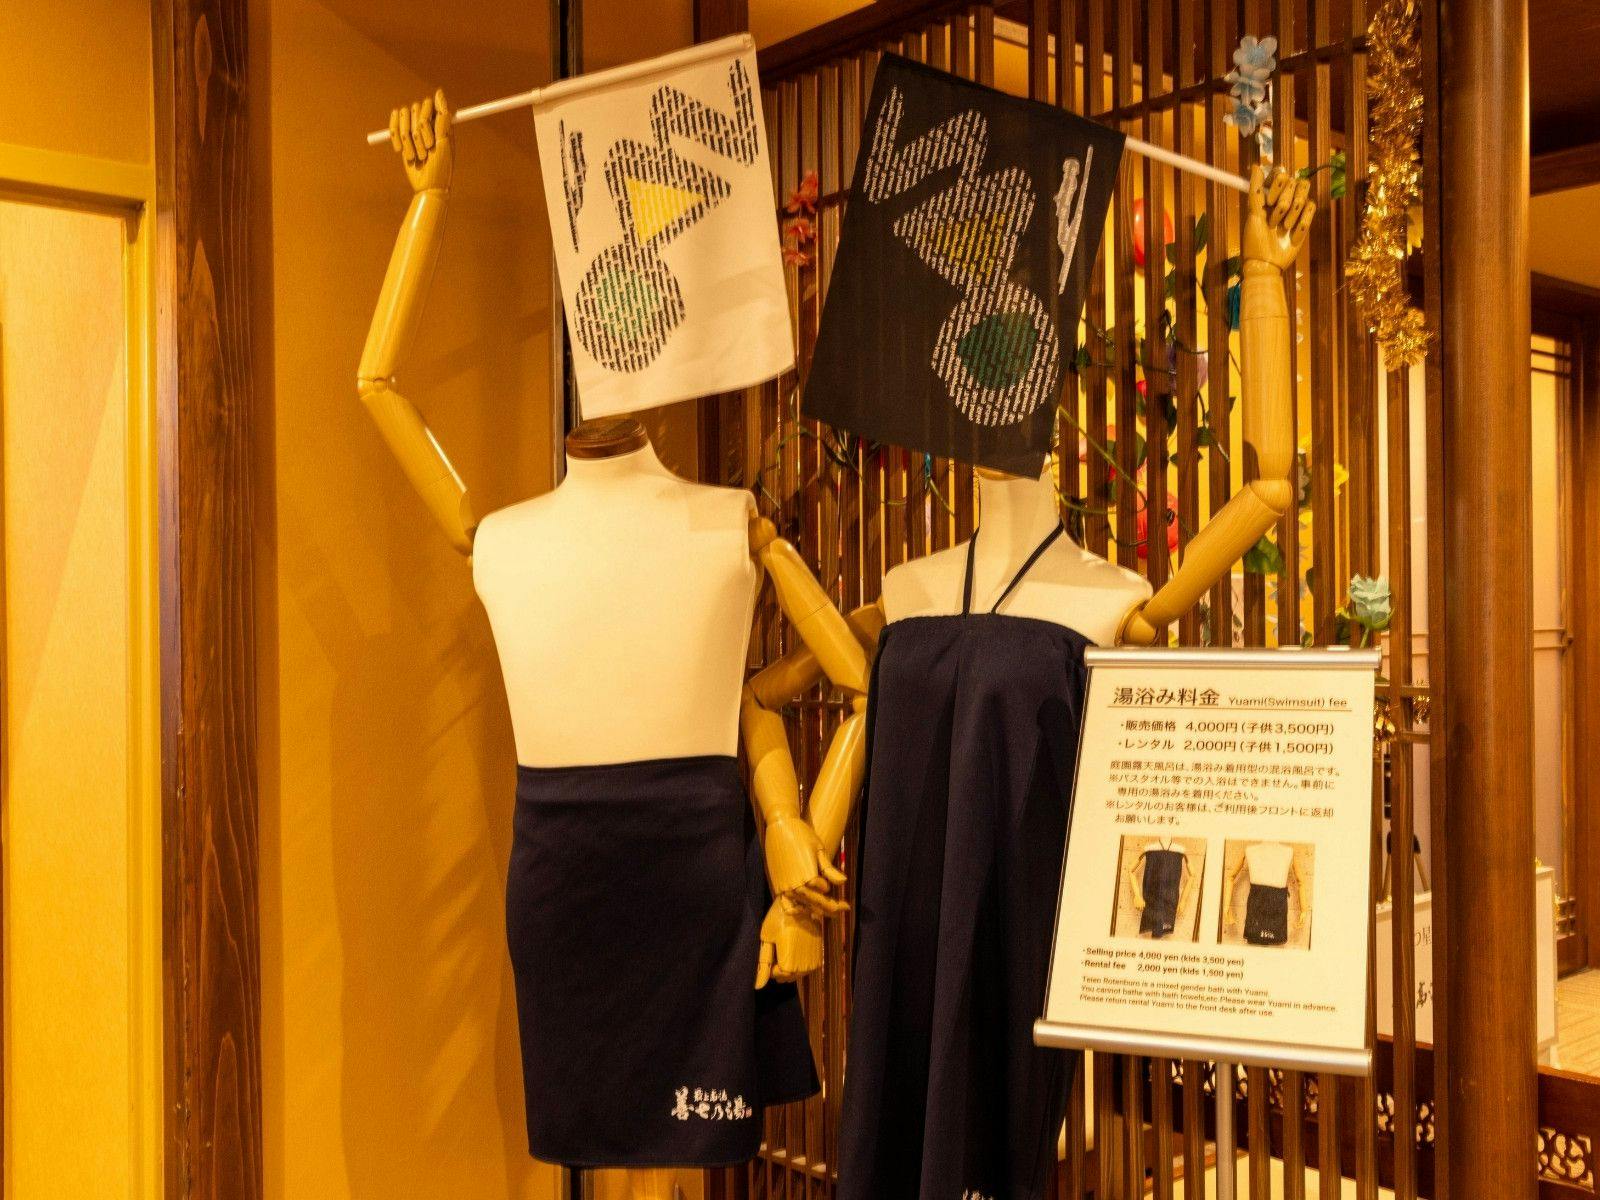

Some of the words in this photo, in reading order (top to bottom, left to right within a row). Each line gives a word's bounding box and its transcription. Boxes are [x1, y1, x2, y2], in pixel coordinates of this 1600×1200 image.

[1113, 687, 1220, 707] 湯浴み料金
[1228, 696, 1325, 709] Yuami(Swimsuit)
[1329, 698, 1348, 708] fee
[1115, 950, 1136, 959] price
[1139, 952, 1162, 960] 4,000
[1164, 954, 1179, 962] yen
[1180, 954, 1200, 962] (kids
[1227, 958, 1244, 967] yen)
[1113, 962, 1126, 970] fee
[1137, 963, 1161, 972] 2,000
[1179, 967, 1200, 976] (kids
[1226, 971, 1244, 980] yen)
[1180, 984, 1206, 993] gender
